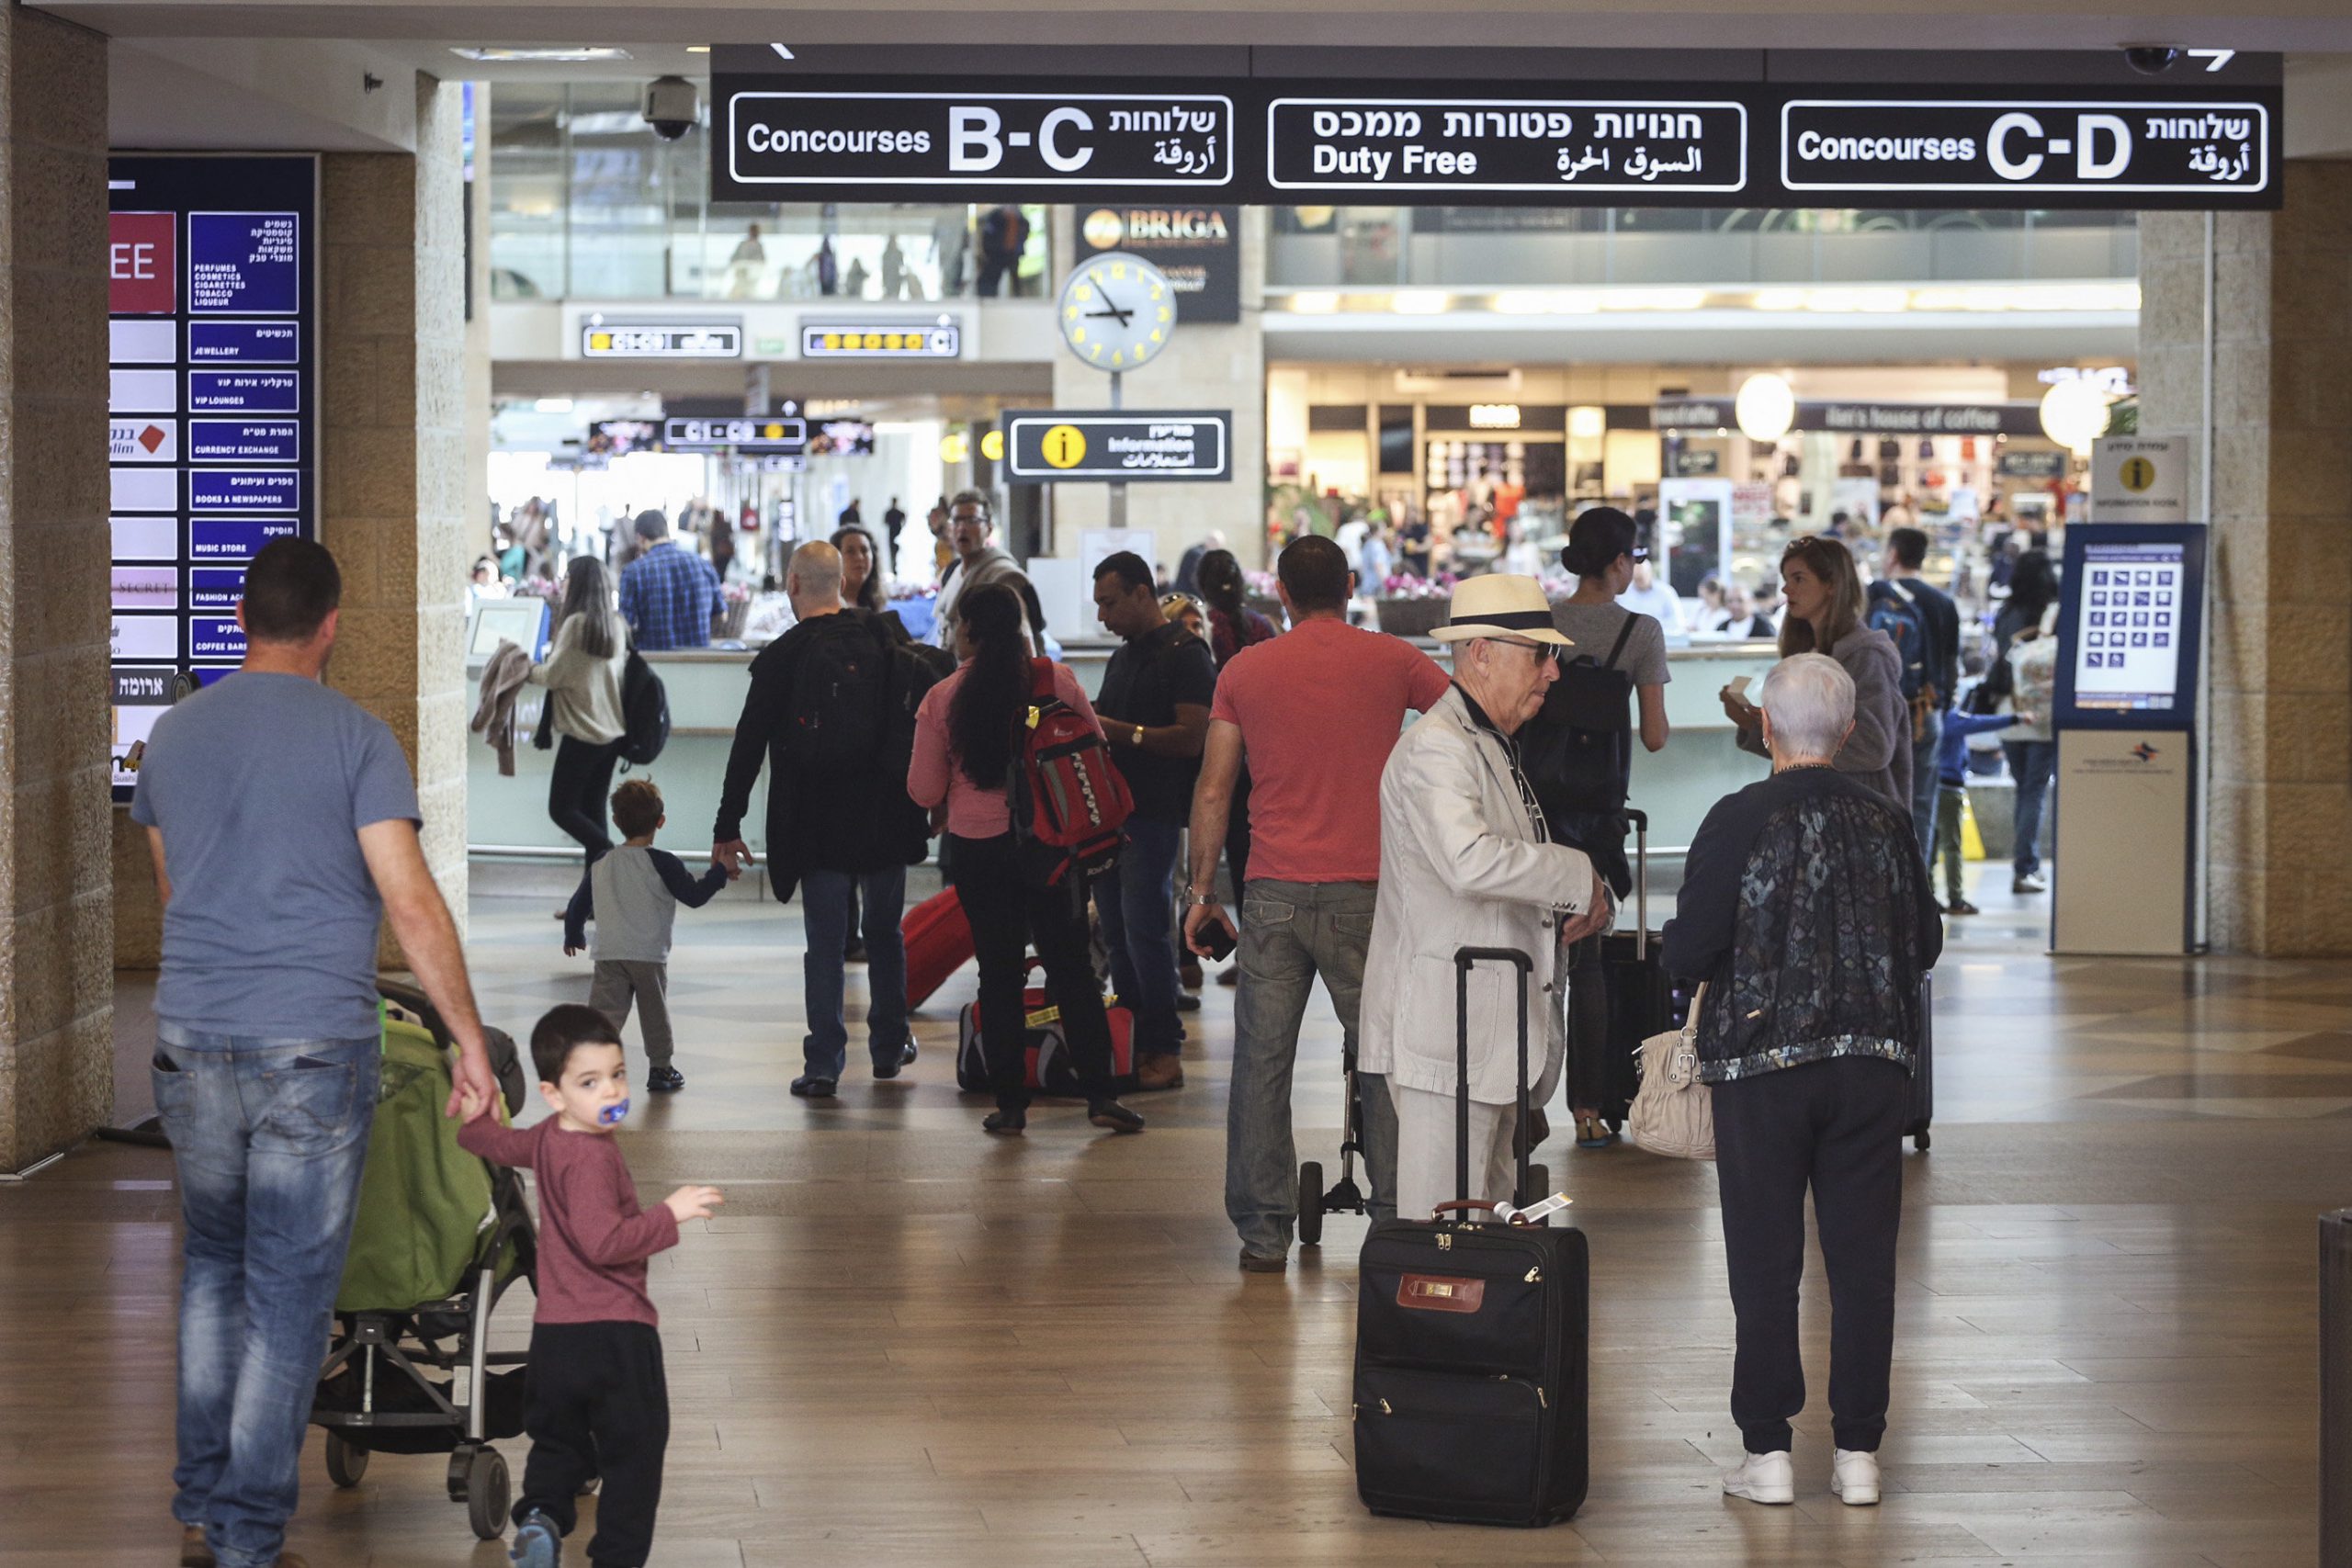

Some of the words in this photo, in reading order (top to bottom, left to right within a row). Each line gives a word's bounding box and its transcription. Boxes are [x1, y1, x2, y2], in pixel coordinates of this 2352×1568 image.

[1109, 106, 1216, 133] שלוחות
[1312, 110, 1421, 138] ממכס
[1442, 111, 1573, 139] פטורות
[1594, 112, 1702, 140] חנויות
[2145, 112, 2251, 141] שלוחות
[746, 122, 931, 154] Concourses
[948, 106, 1094, 173] B-C
[1797, 130, 1976, 162] Concourses
[1986, 112, 2132, 180] C-D
[1153, 137, 1216, 175] أروقة
[1313, 144, 1392, 181] Duty
[1403, 144, 1477, 175] Free
[1556, 145, 1610, 181] الحرة
[1623, 145, 1702, 181] السوق
[2188, 142, 2250, 180] أروقة
[194, 264, 237, 272] PERFUMES
[194, 272, 242, 281] COSMETICS
[194, 281, 246, 289] CIGARETTES
[195, 289, 233, 298] TOBACCO
[194, 298, 230, 306] LIQUEUR
[195, 346, 239, 355] JEWELLERY
[217, 378, 231, 387] VIP
[195, 396, 208, 405] VIP
[209, 396, 244, 405] LOUNGES
[195, 446, 236, 454] CURRENCY
[237, 446, 279, 454] EXCHANGE
[195, 495, 222, 503] BOOKS
[232, 495, 283, 503] NEWSPAPERS
[195, 544, 220, 552] MUSIC
[221, 544, 246, 552] STORE
[195, 593, 228, 602] FASHION
[195, 642, 226, 651] COFFEE
[119, 677, 164, 696] ארומה
